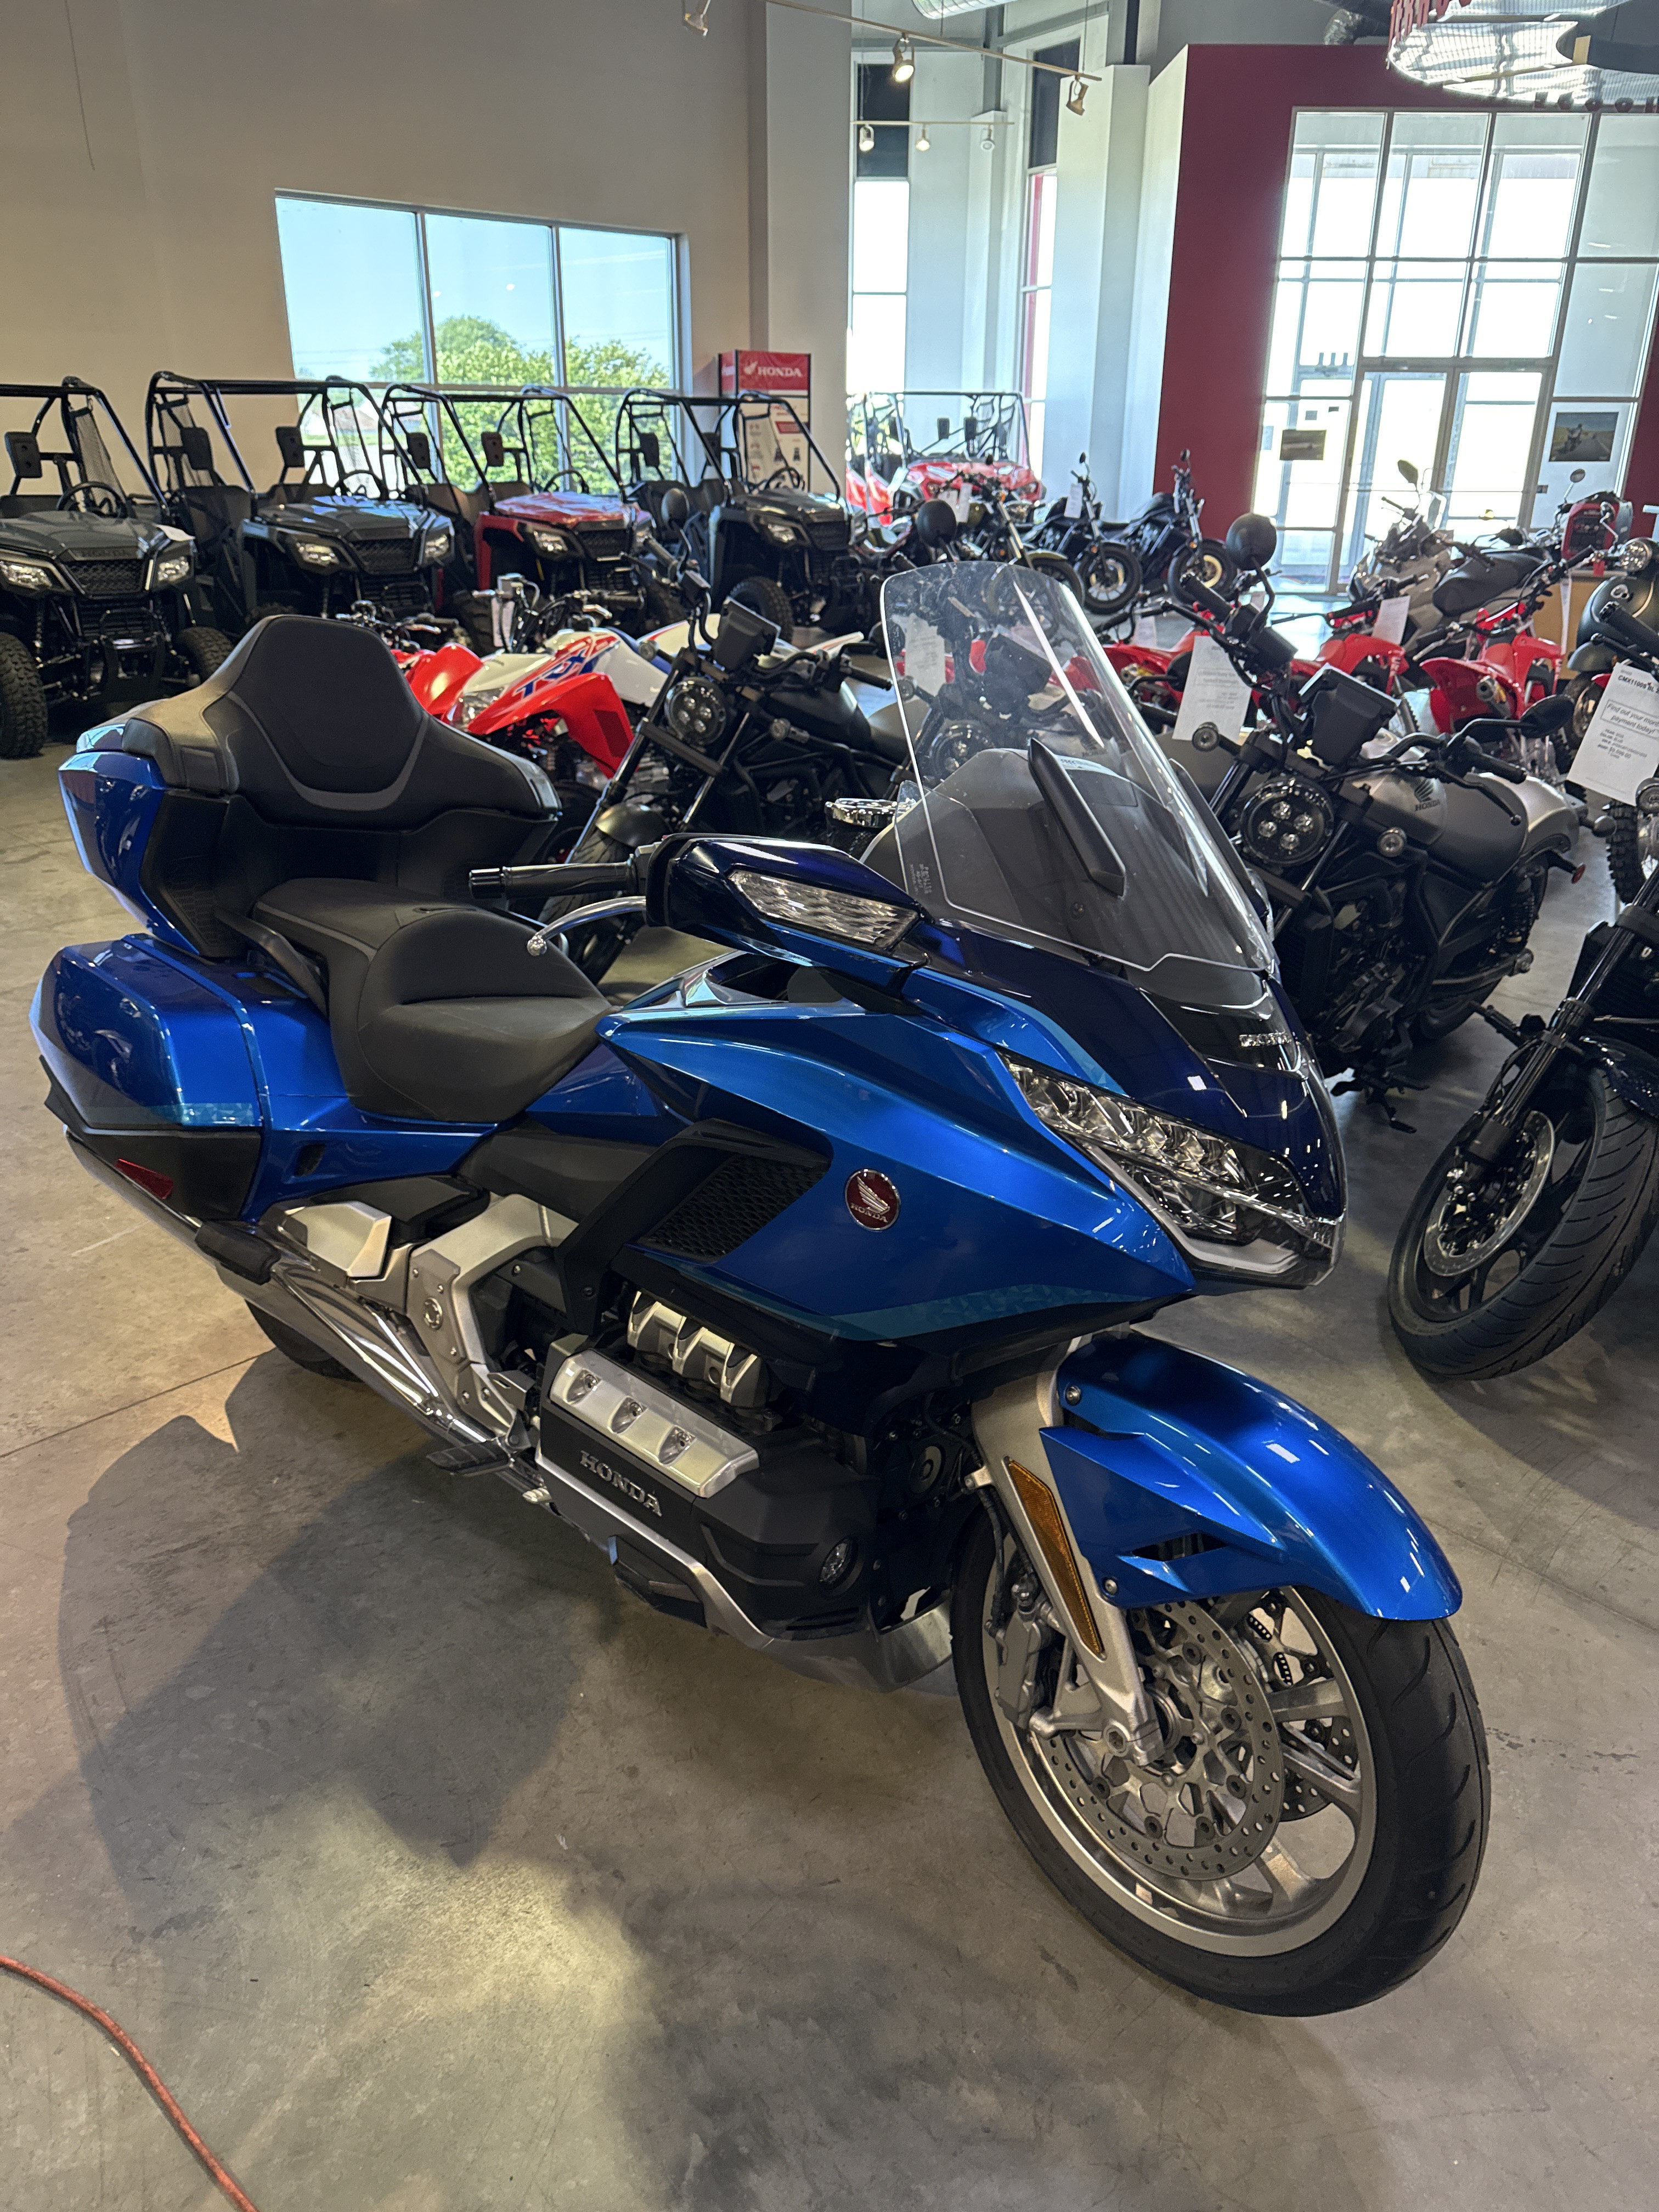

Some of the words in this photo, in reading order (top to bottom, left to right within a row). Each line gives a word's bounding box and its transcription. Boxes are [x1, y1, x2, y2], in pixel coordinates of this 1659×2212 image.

[758, 366, 803, 377] HONDA
[1607, 703, 1620, 712] Find
[1629, 713, 1643, 722] your
[1611, 715, 1637, 728] payment
[1415, 799, 1440, 811] HONDA
[850, 1203, 888, 1223] HONDA
[580, 1450, 662, 1517] HONDA
